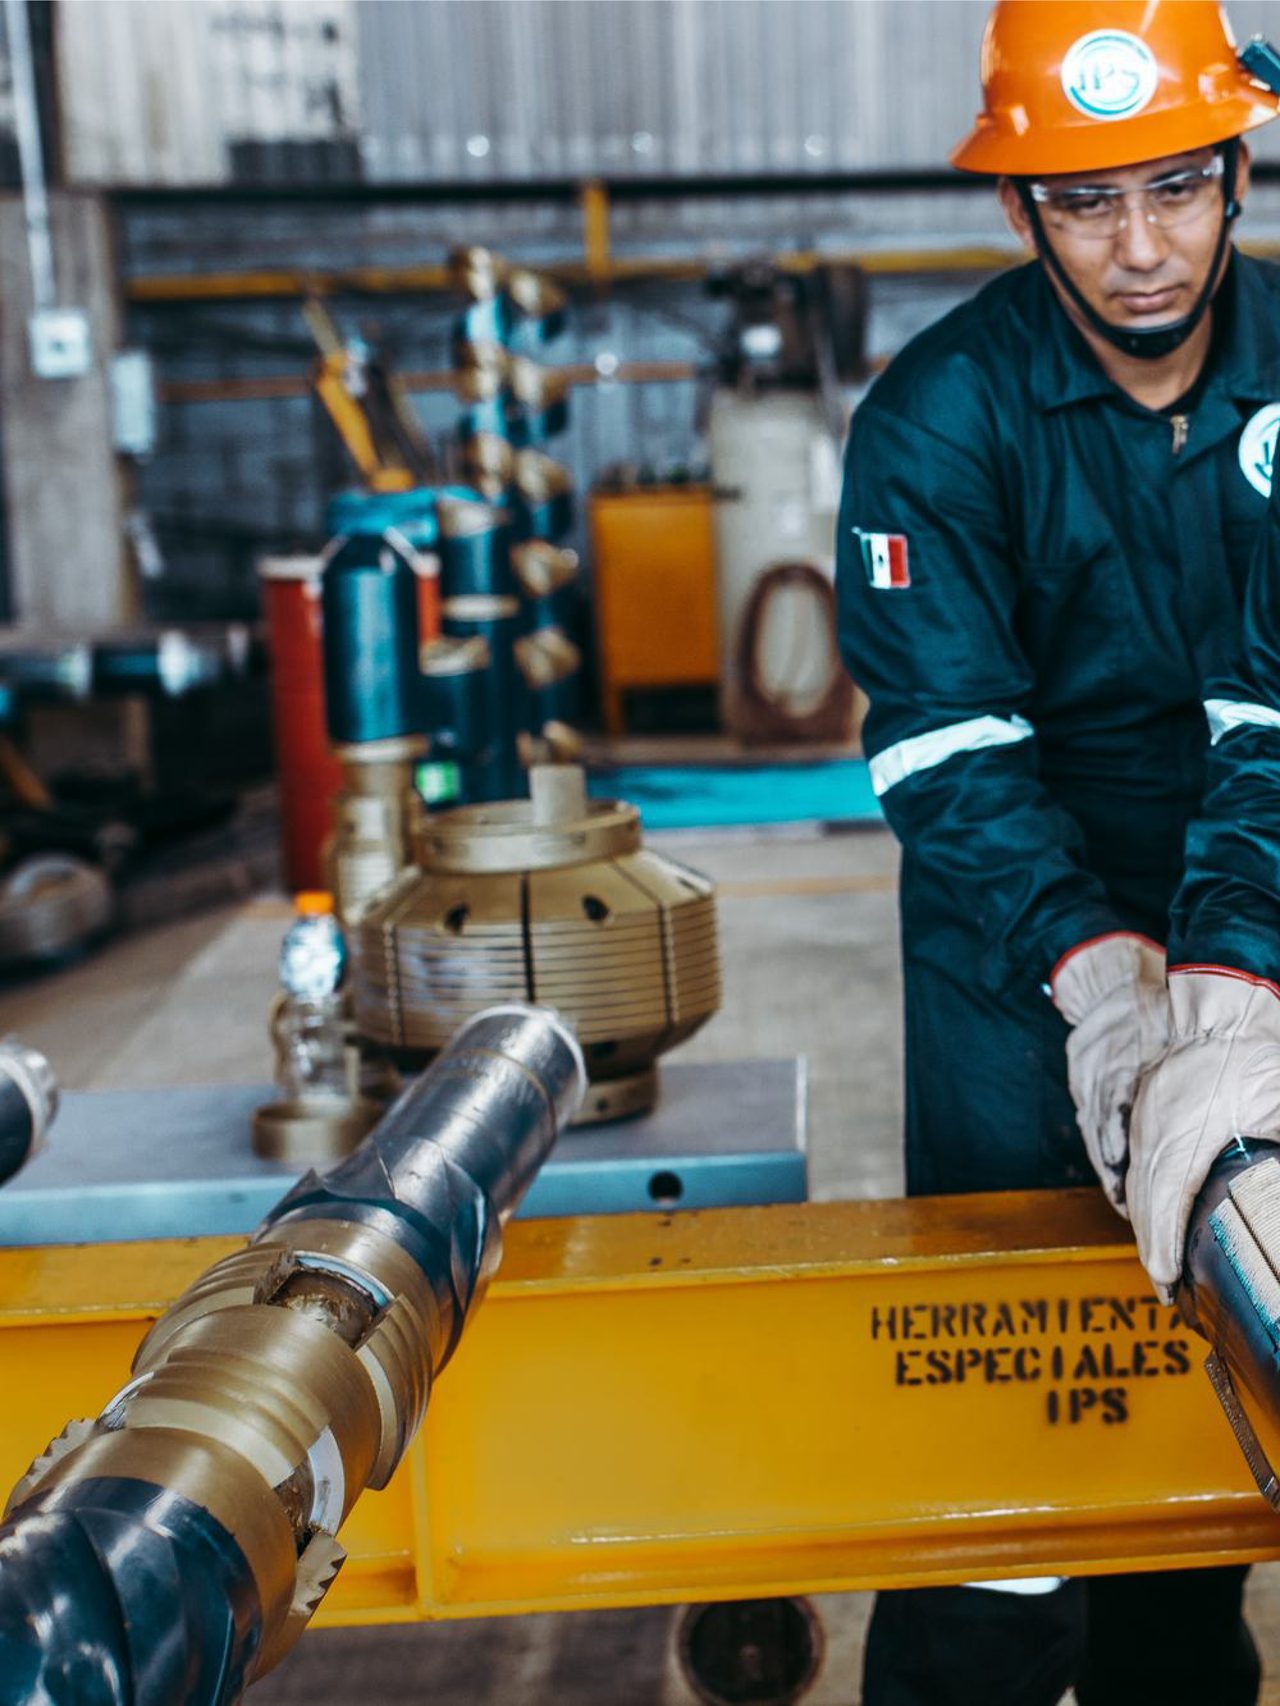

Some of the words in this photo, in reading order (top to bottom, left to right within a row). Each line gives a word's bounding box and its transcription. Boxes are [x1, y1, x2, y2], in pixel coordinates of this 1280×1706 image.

[1079, 62, 1141, 92] IPS
[896, 1340, 1191, 1386] ESPECIALES
[1047, 1387, 1128, 1425] IPS
